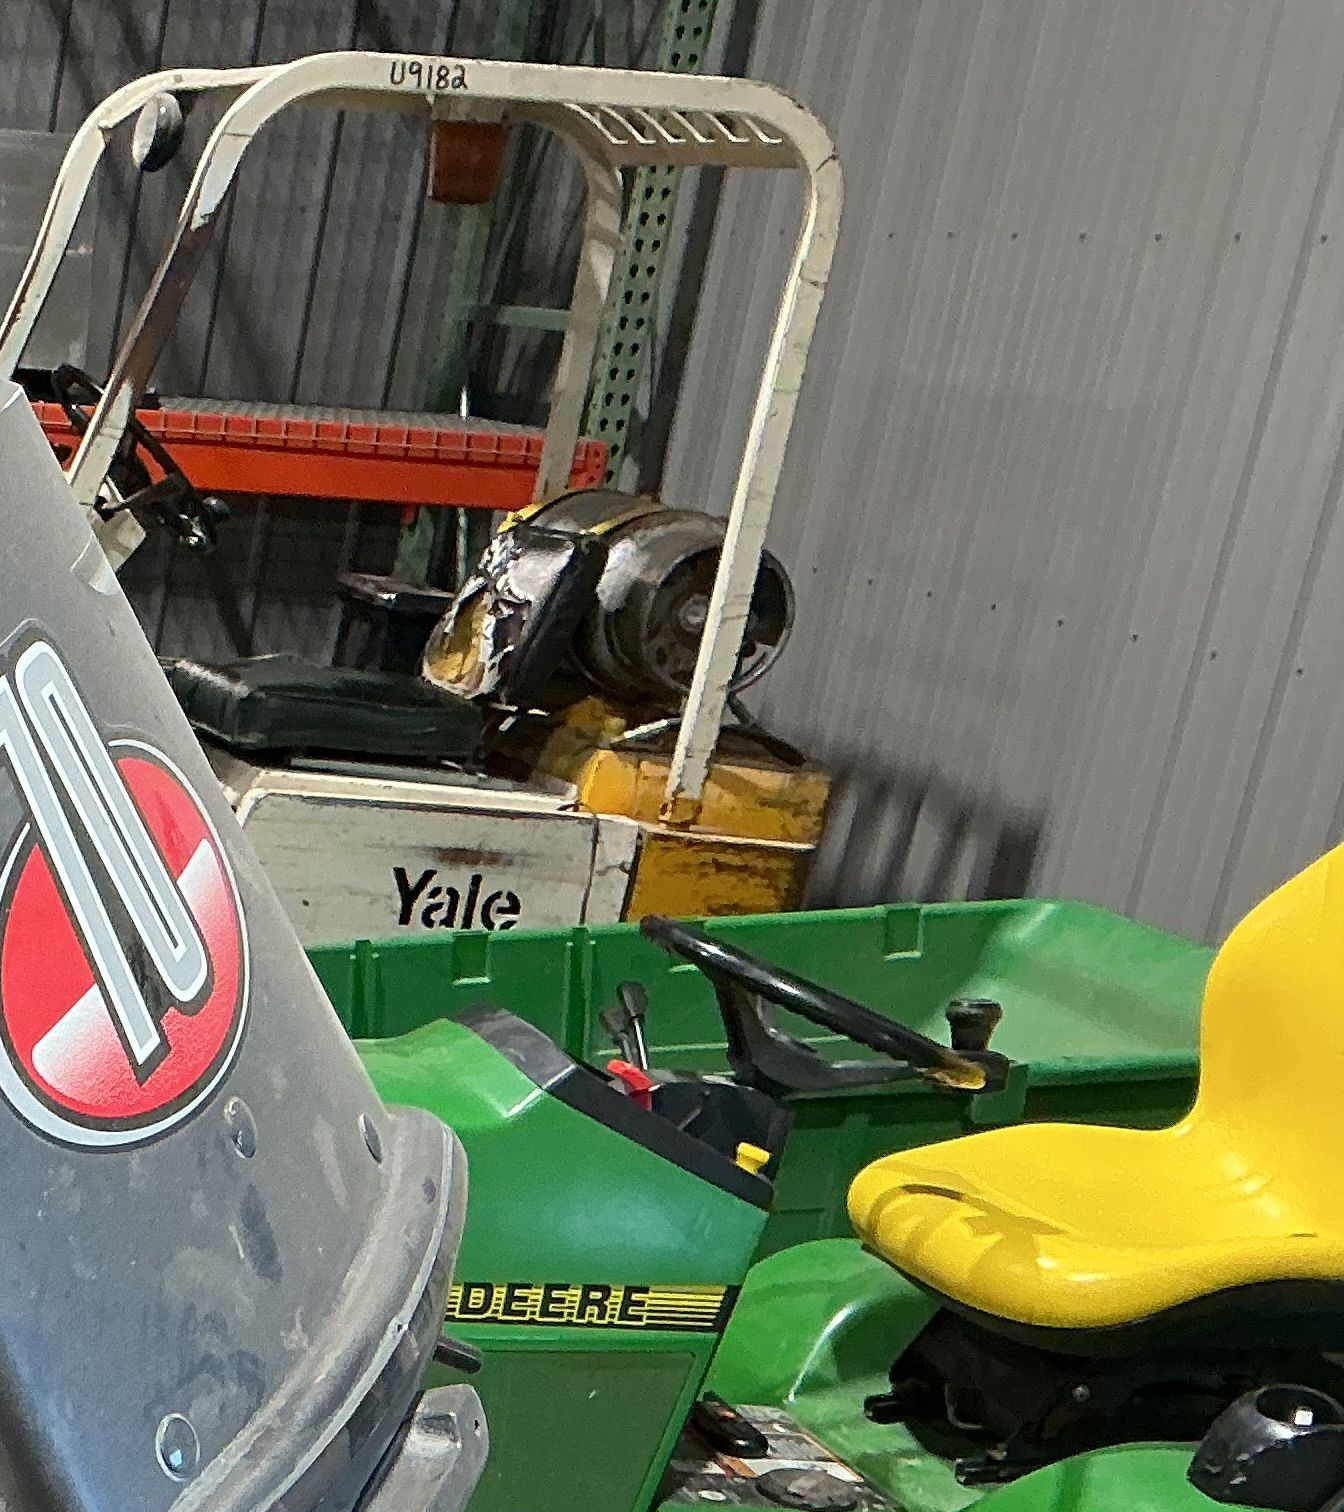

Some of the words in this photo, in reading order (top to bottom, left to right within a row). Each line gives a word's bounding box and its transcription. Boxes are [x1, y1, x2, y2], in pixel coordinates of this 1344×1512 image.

[390, 61, 469, 90] U9182
[392, 867, 521, 931] Yale
[455, 1282, 650, 1326] DEERE
